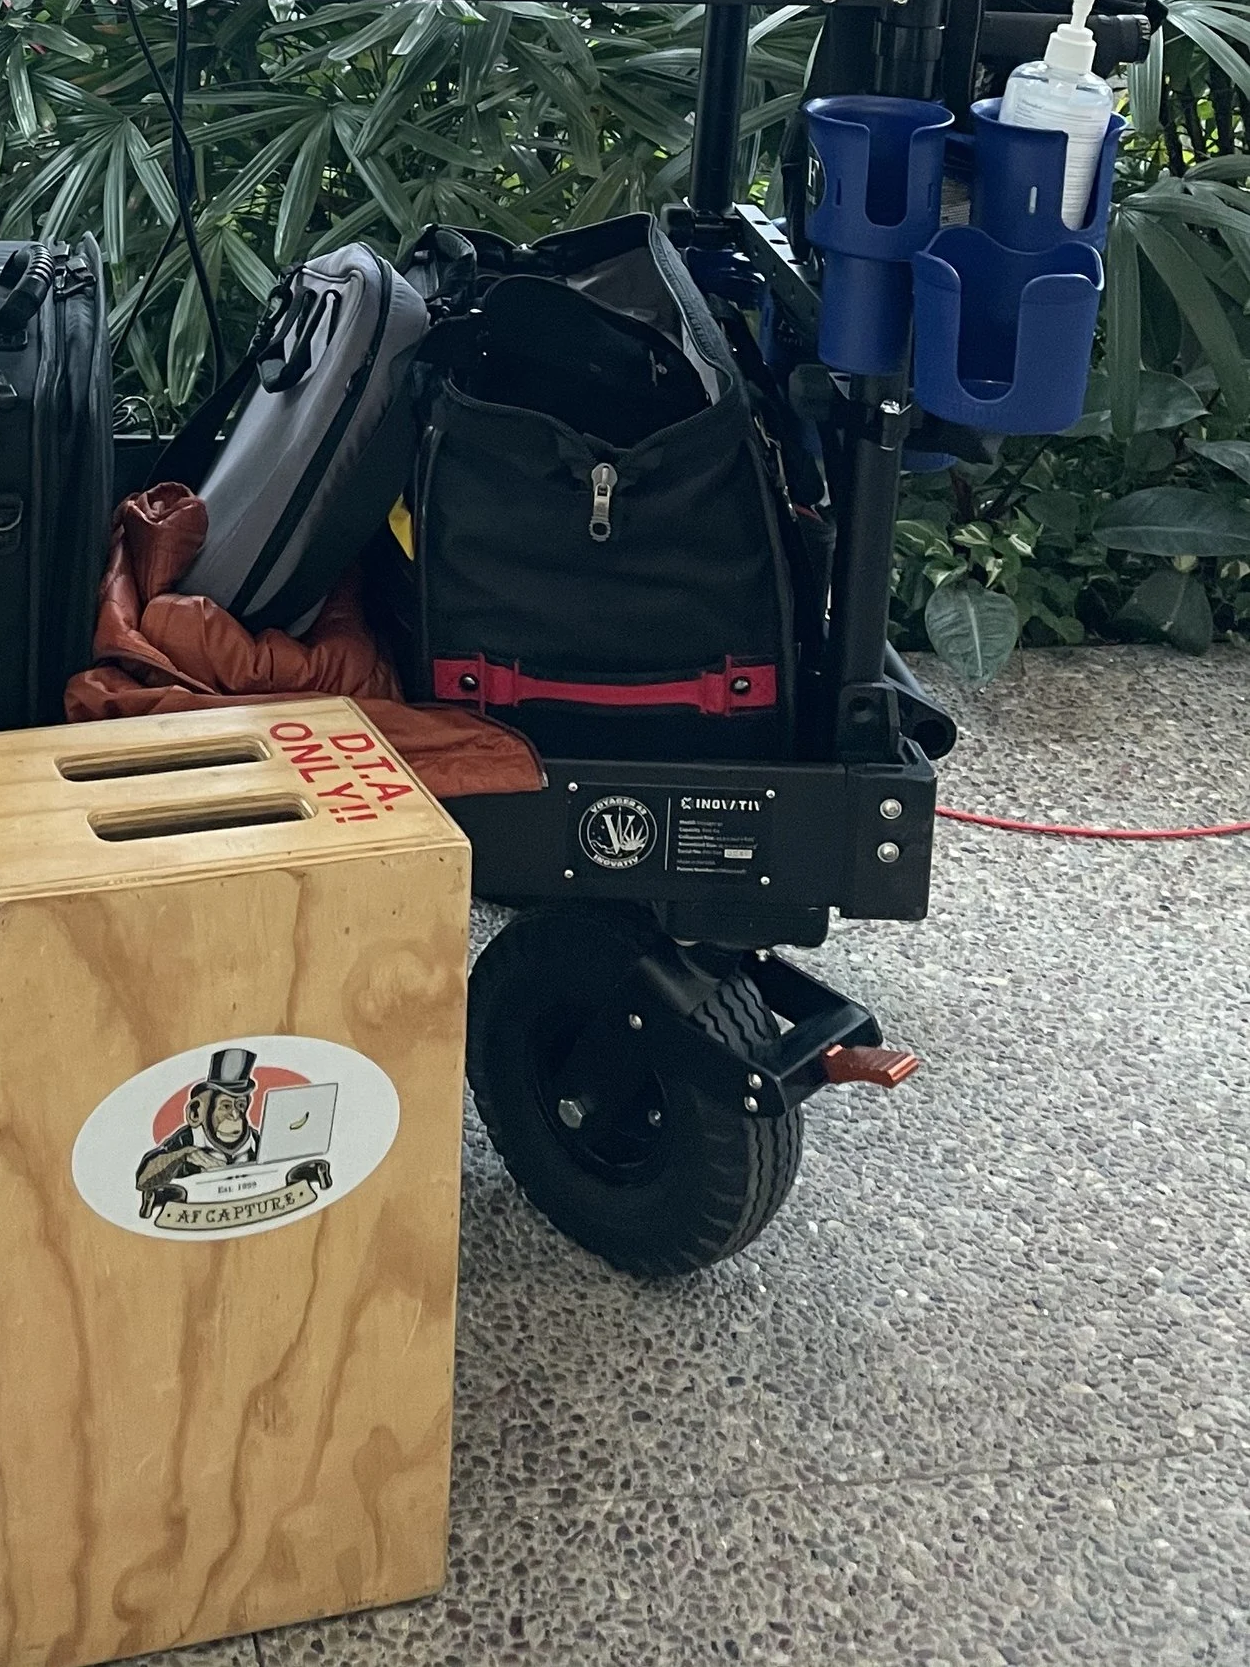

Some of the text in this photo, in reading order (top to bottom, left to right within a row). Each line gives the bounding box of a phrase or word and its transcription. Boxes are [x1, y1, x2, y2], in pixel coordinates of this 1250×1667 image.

[269, 722, 378, 824] ONLY!!
[328, 733, 414, 812] D.T.A.
[177, 1192, 295, 1224] AF CAPTURE
